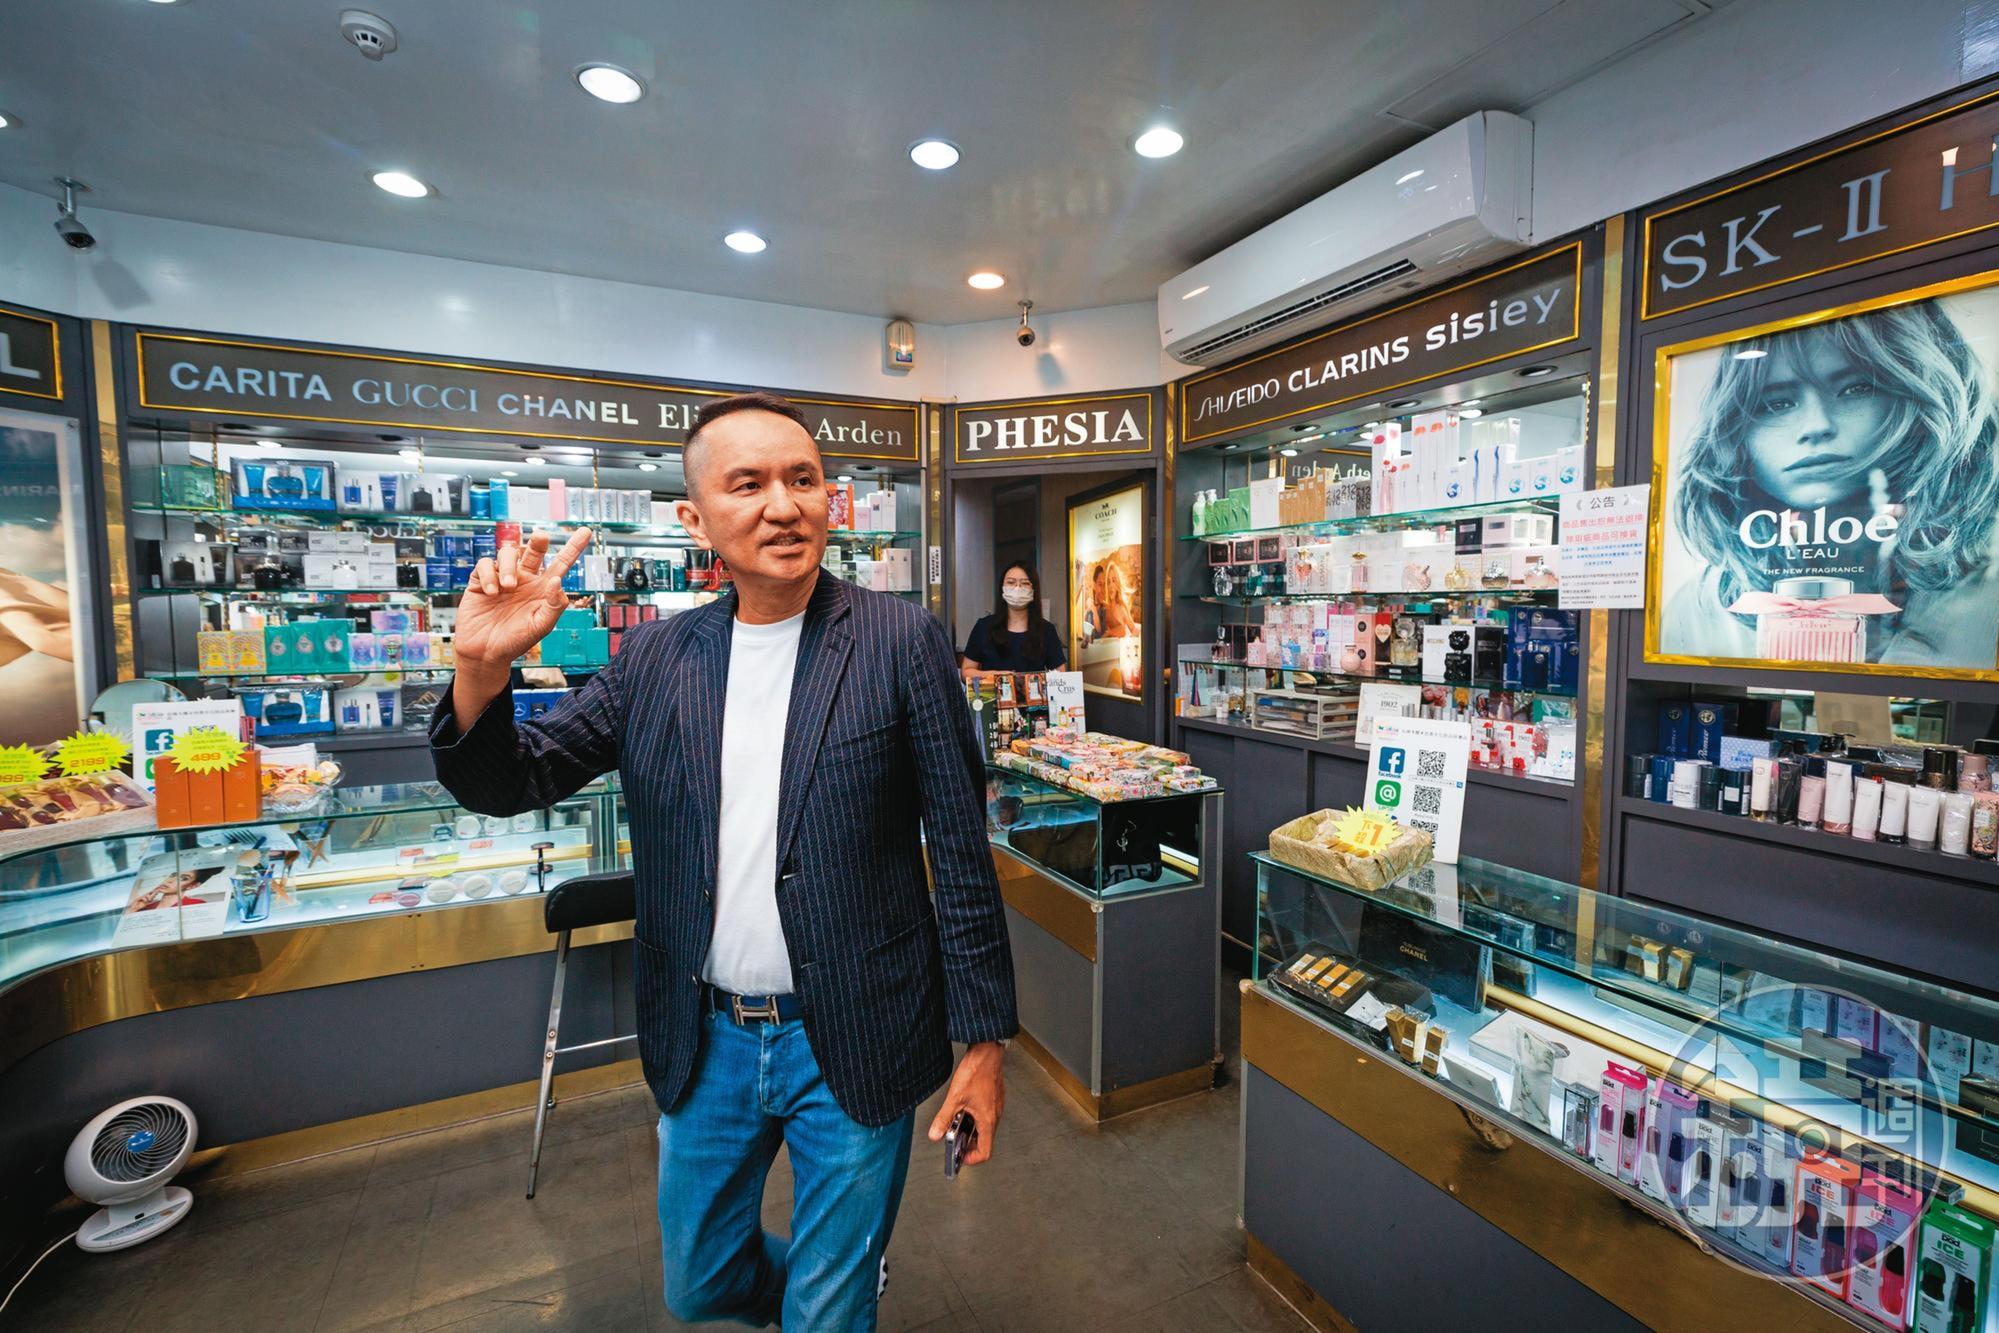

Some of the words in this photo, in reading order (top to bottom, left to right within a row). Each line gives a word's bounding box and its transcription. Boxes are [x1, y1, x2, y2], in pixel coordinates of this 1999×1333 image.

[1193, 378, 1281, 422] SHISEIDO
[1287, 336, 1410, 393] CLARINS
[169, 361, 332, 401] CARITA
[352, 378, 478, 413] GUCCI
[497, 393, 639, 426] CHANEL
[814, 417, 903, 447] Arden
[965, 408, 1144, 452] PHESIA
[1341, 483, 1357, 496] 212
[1095, 508, 1117, 520] COACH
[1785, 547, 1839, 560] L'EAU
[1805, 566, 1865, 574] FRAGRANCE
[1380, 700, 1398, 708] 1902
[1399, 944, 1429, 962] CHANEL
[1811, 1183, 1835, 1200] ICE
[1870, 1208, 1896, 1227] ICE
[1936, 1239, 1965, 1261] ICE
